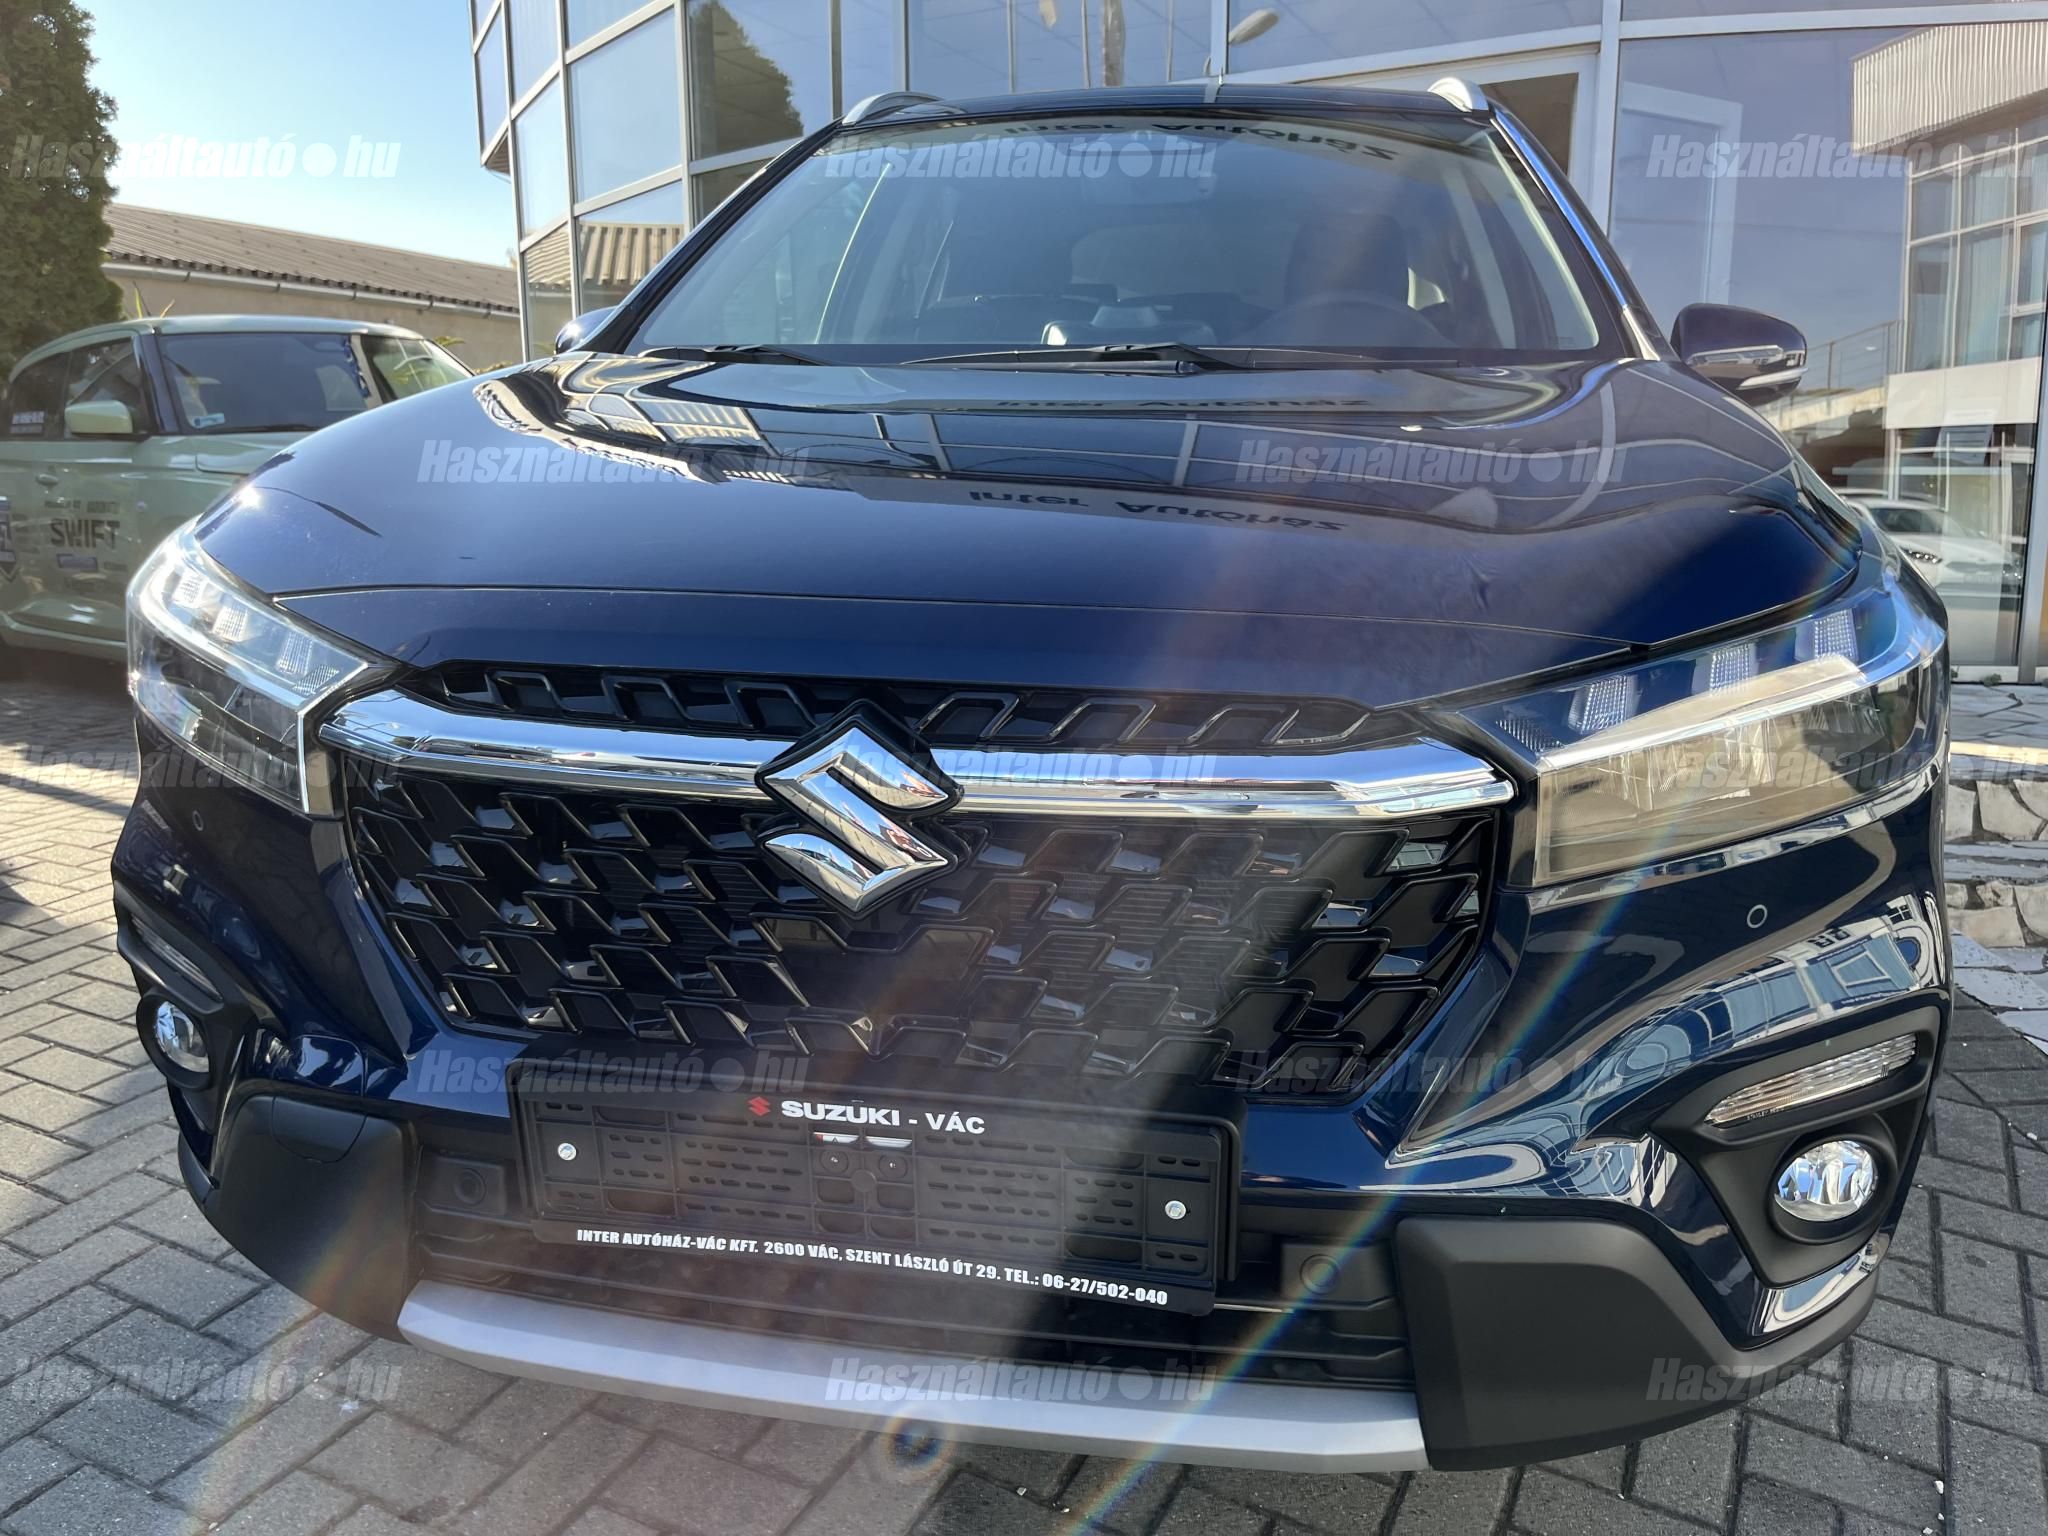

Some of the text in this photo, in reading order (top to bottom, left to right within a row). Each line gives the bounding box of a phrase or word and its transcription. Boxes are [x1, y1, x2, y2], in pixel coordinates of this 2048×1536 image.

[50, 518, 121, 550] SWIFT
[781, 1100, 900, 1126] SUZUKI
[925, 1111, 985, 1134] VÁC
[577, 1229, 1168, 1305] INTER AUTÓHÁZ-VÁC KFT. 2600 VÁC, SZENT LÁSZLÓ ÚT 29. TEL.: 06-27/502-040
